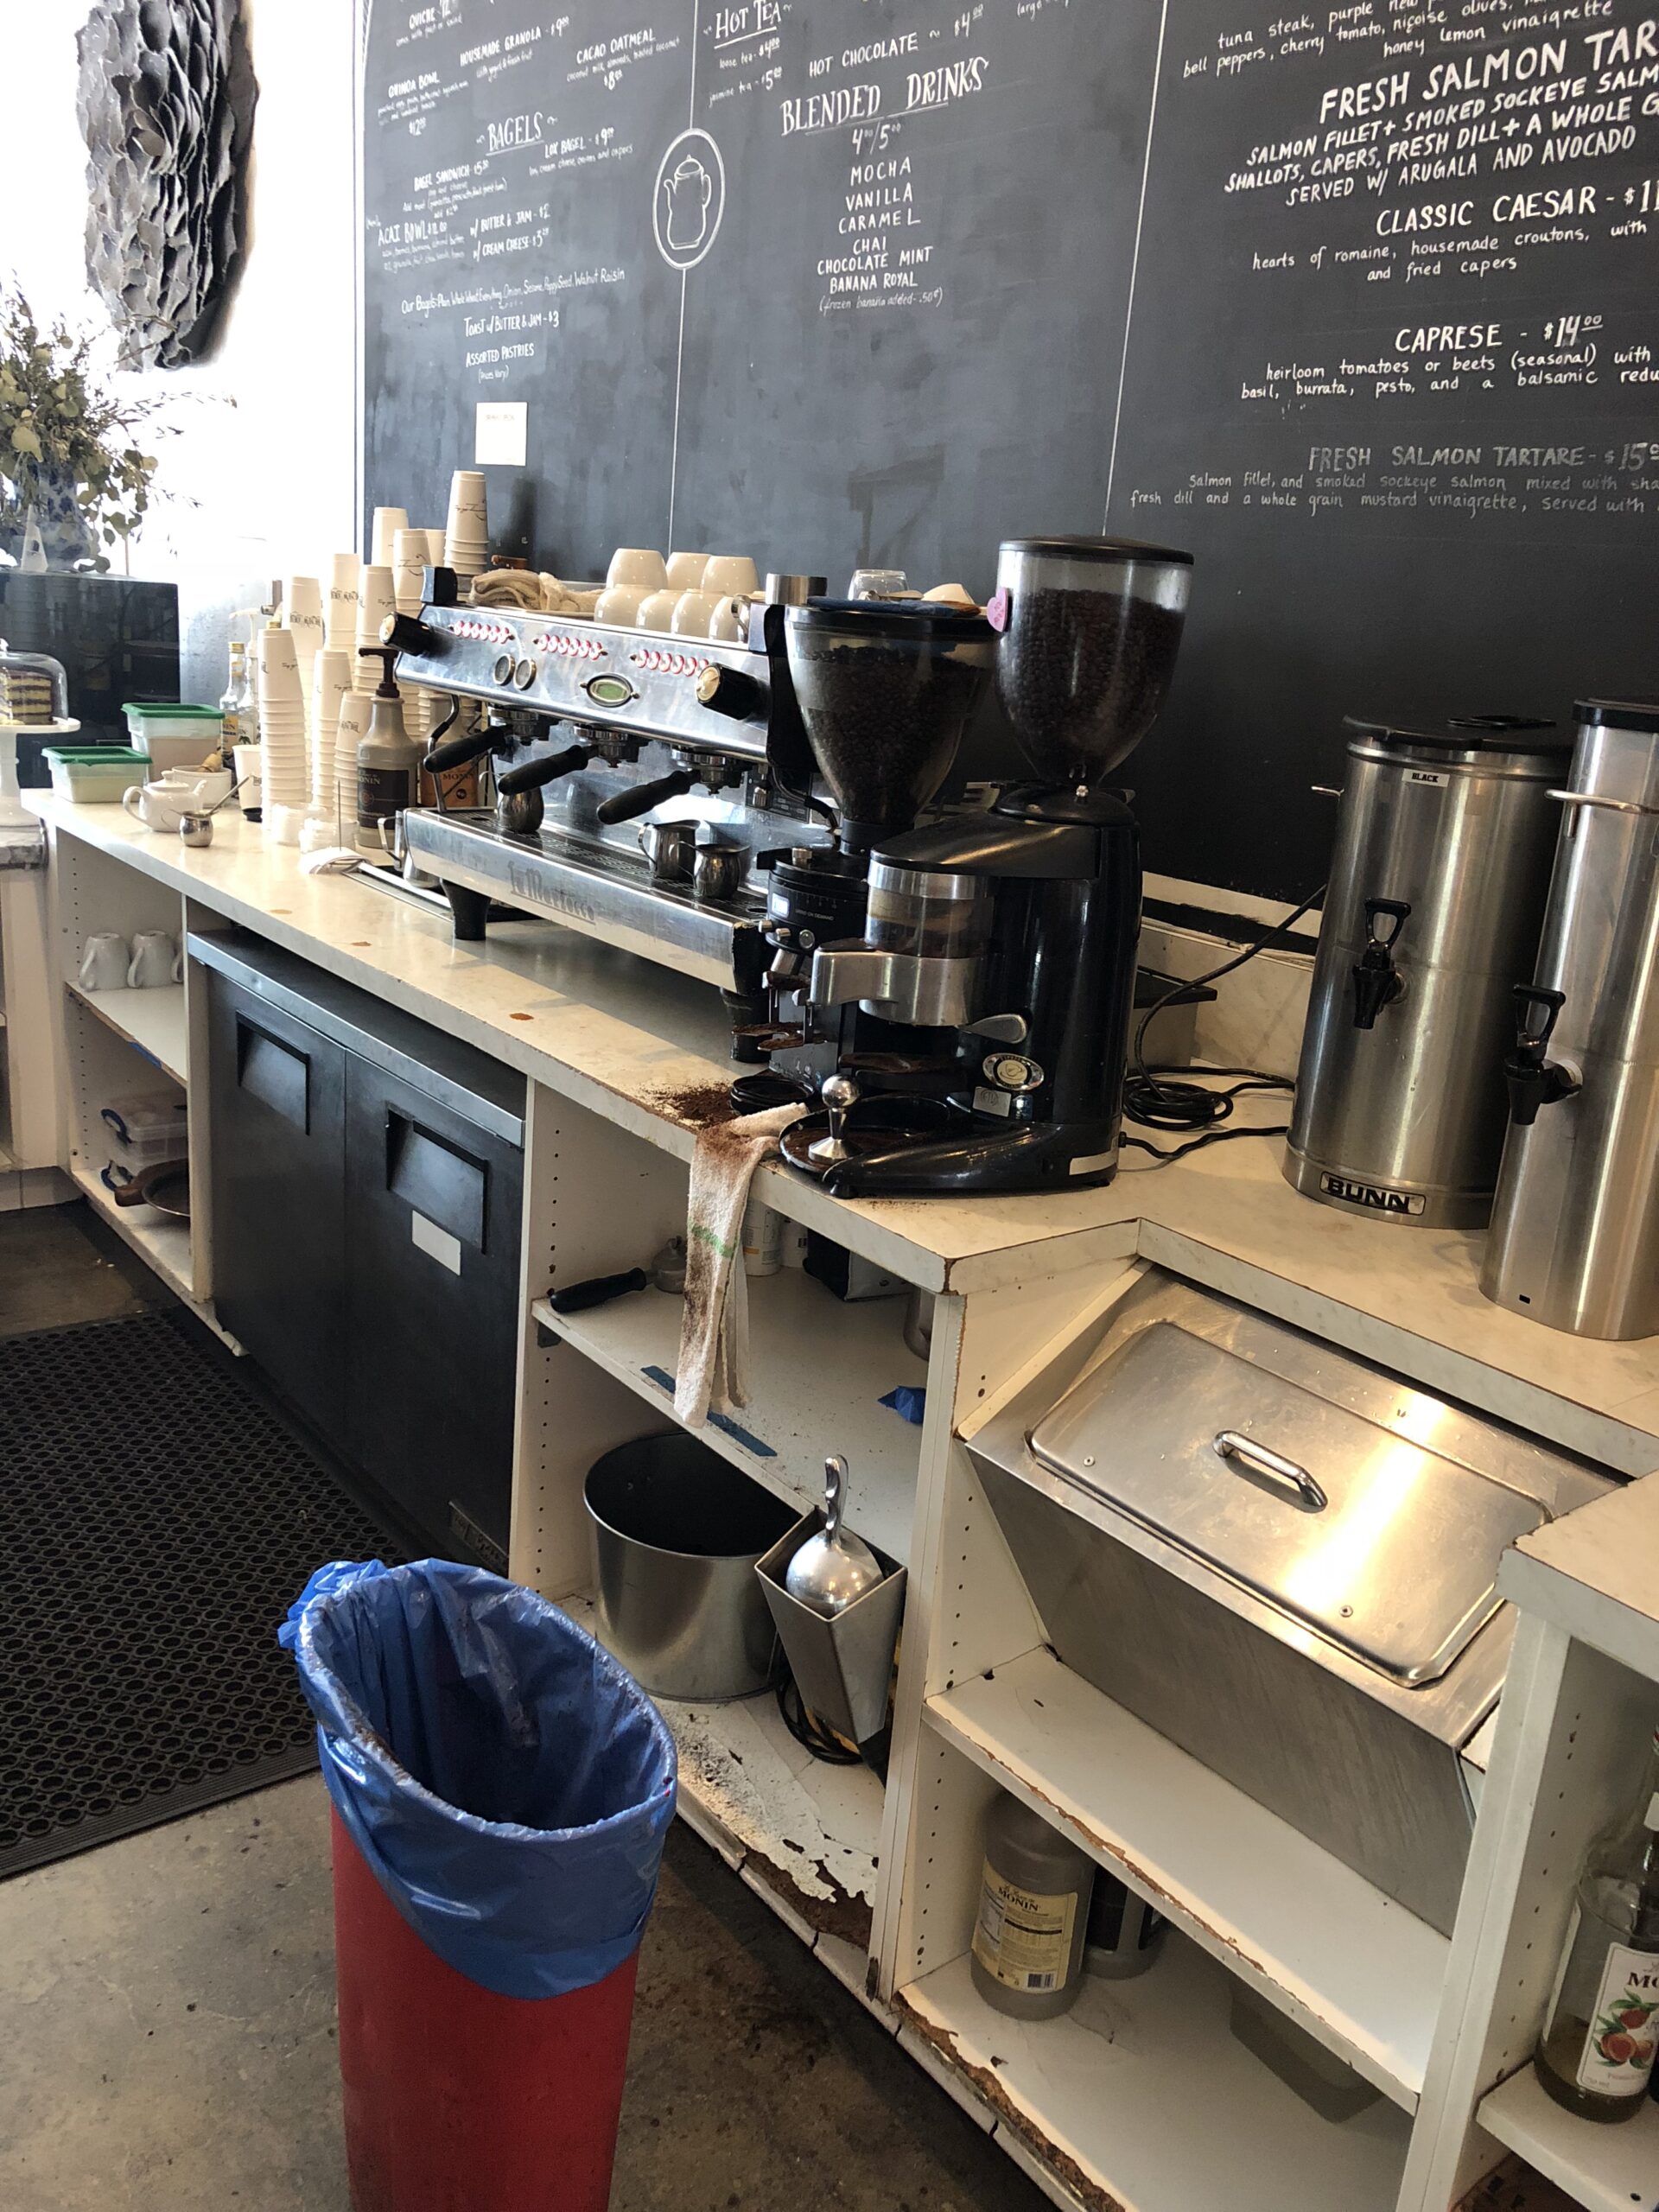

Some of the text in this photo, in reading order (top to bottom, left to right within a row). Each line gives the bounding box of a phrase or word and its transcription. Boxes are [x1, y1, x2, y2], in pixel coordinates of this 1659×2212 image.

[715, 0, 782, 40] HOT TEA
[1217, 30, 1254, 50] tuna
[1268, 13, 1315, 38] steak,
[1328, 1, 1374, 33] purple
[1383, 0, 1613, 59] honey lemon vinaigrette
[460, 39, 501, 67] HOUSEMADE
[505, 26, 542, 51] GRANOLA
[576, 28, 656, 65] CACAO OATMEAL
[809, 31, 919, 79] HOT CHOCOLATE
[1183, 55, 1208, 79] bell
[1280, 35, 1325, 58] cherry
[1336, 21, 1385, 42] tomato,
[418, 71, 441, 90] BOWL
[779, 56, 989, 136] BLENDED DRINKS
[1319, 71, 1411, 124] FRESH
[1421, 39, 1566, 101] SALMON
[487, 111, 543, 152] BAGELS
[1246, 135, 1318, 166] SALMON
[1402, 99, 1486, 132] SMOKED
[1490, 76, 1588, 114] SOCKEYE
[561, 136, 587, 155] BAGEL
[1224, 163, 1306, 193] SHALLOTS,
[1310, 146, 1382, 177] CAPERS,
[1387, 131, 1450, 164] FRESH
[1525, 112, 1542, 137] A
[1551, 95, 1633, 130] WHOLE
[850, 156, 912, 187] MOCHA
[1285, 124, 1637, 207] SERVED W/ ARUGALA AND AVOCADO
[845, 181, 913, 213] VANILLA
[1376, 185, 1597, 237] CLASSIC CAESAR
[378, 224, 400, 246] ACAI
[404, 219, 429, 244] BOWL
[480, 213, 505, 232] BUTTER
[515, 209, 532, 225] JAM
[838, 207, 921, 235] CARAMEL
[482, 240, 505, 257] CREAM
[505, 235, 530, 252] CHEESE
[853, 235, 887, 256] CHAI
[1253, 219, 1648, 270] hearts of romaine, housemade croutons, with
[817, 245, 934, 276] CHOCOLATE MINT
[1367, 257, 1517, 283] and fried capers
[401, 299, 415, 315] Our
[574, 270, 599, 287] Walnut
[601, 267, 625, 283] Raisin
[830, 270, 918, 295] BANANA ROYAL
[528, 311, 542, 327] JAM
[819, 295, 851, 317] (frozen
[855, 295, 886, 309] banana
[1394, 323, 1503, 353] CAPRESE
[465, 342, 535, 368] ASSORTED PASTRIES
[1266, 342, 1651, 380] heirloom tomatoes or beets (seasonal) with
[1241, 381, 1280, 400] basil,
[1295, 378, 1355, 397] burrata,
[1375, 377, 1416, 399] pesto,
[1430, 376, 1459, 391] and
[1482, 378, 1495, 389] a
[1516, 368, 1599, 386] balsamic
[1308, 446, 1586, 473] FRESH SALMON TARTARE
[1281, 474, 1304, 488] and
[1315, 473, 1365, 488] smoked
[1380, 474, 1438, 493] sockeye
[1451, 474, 1507, 492] salmon
[1526, 474, 1570, 492] mixed
[1582, 475, 1618, 491] with
[1130, 489, 1162, 508] fresh
[1173, 490, 1193, 505] dill
[1206, 491, 1230, 505] and
[1243, 493, 1252, 505] a
[1262, 492, 1297, 505] whole
[1309, 493, 1344, 517] grain
[1361, 492, 1417, 506] mustard
[1541, 495, 1597, 512] served
[1606, 496, 1644, 513] with
[1411, 772, 1439, 783] BLACK
[1327, 1177, 1410, 1212] BUNN
[998, 1886, 1039, 1911] MONIN
